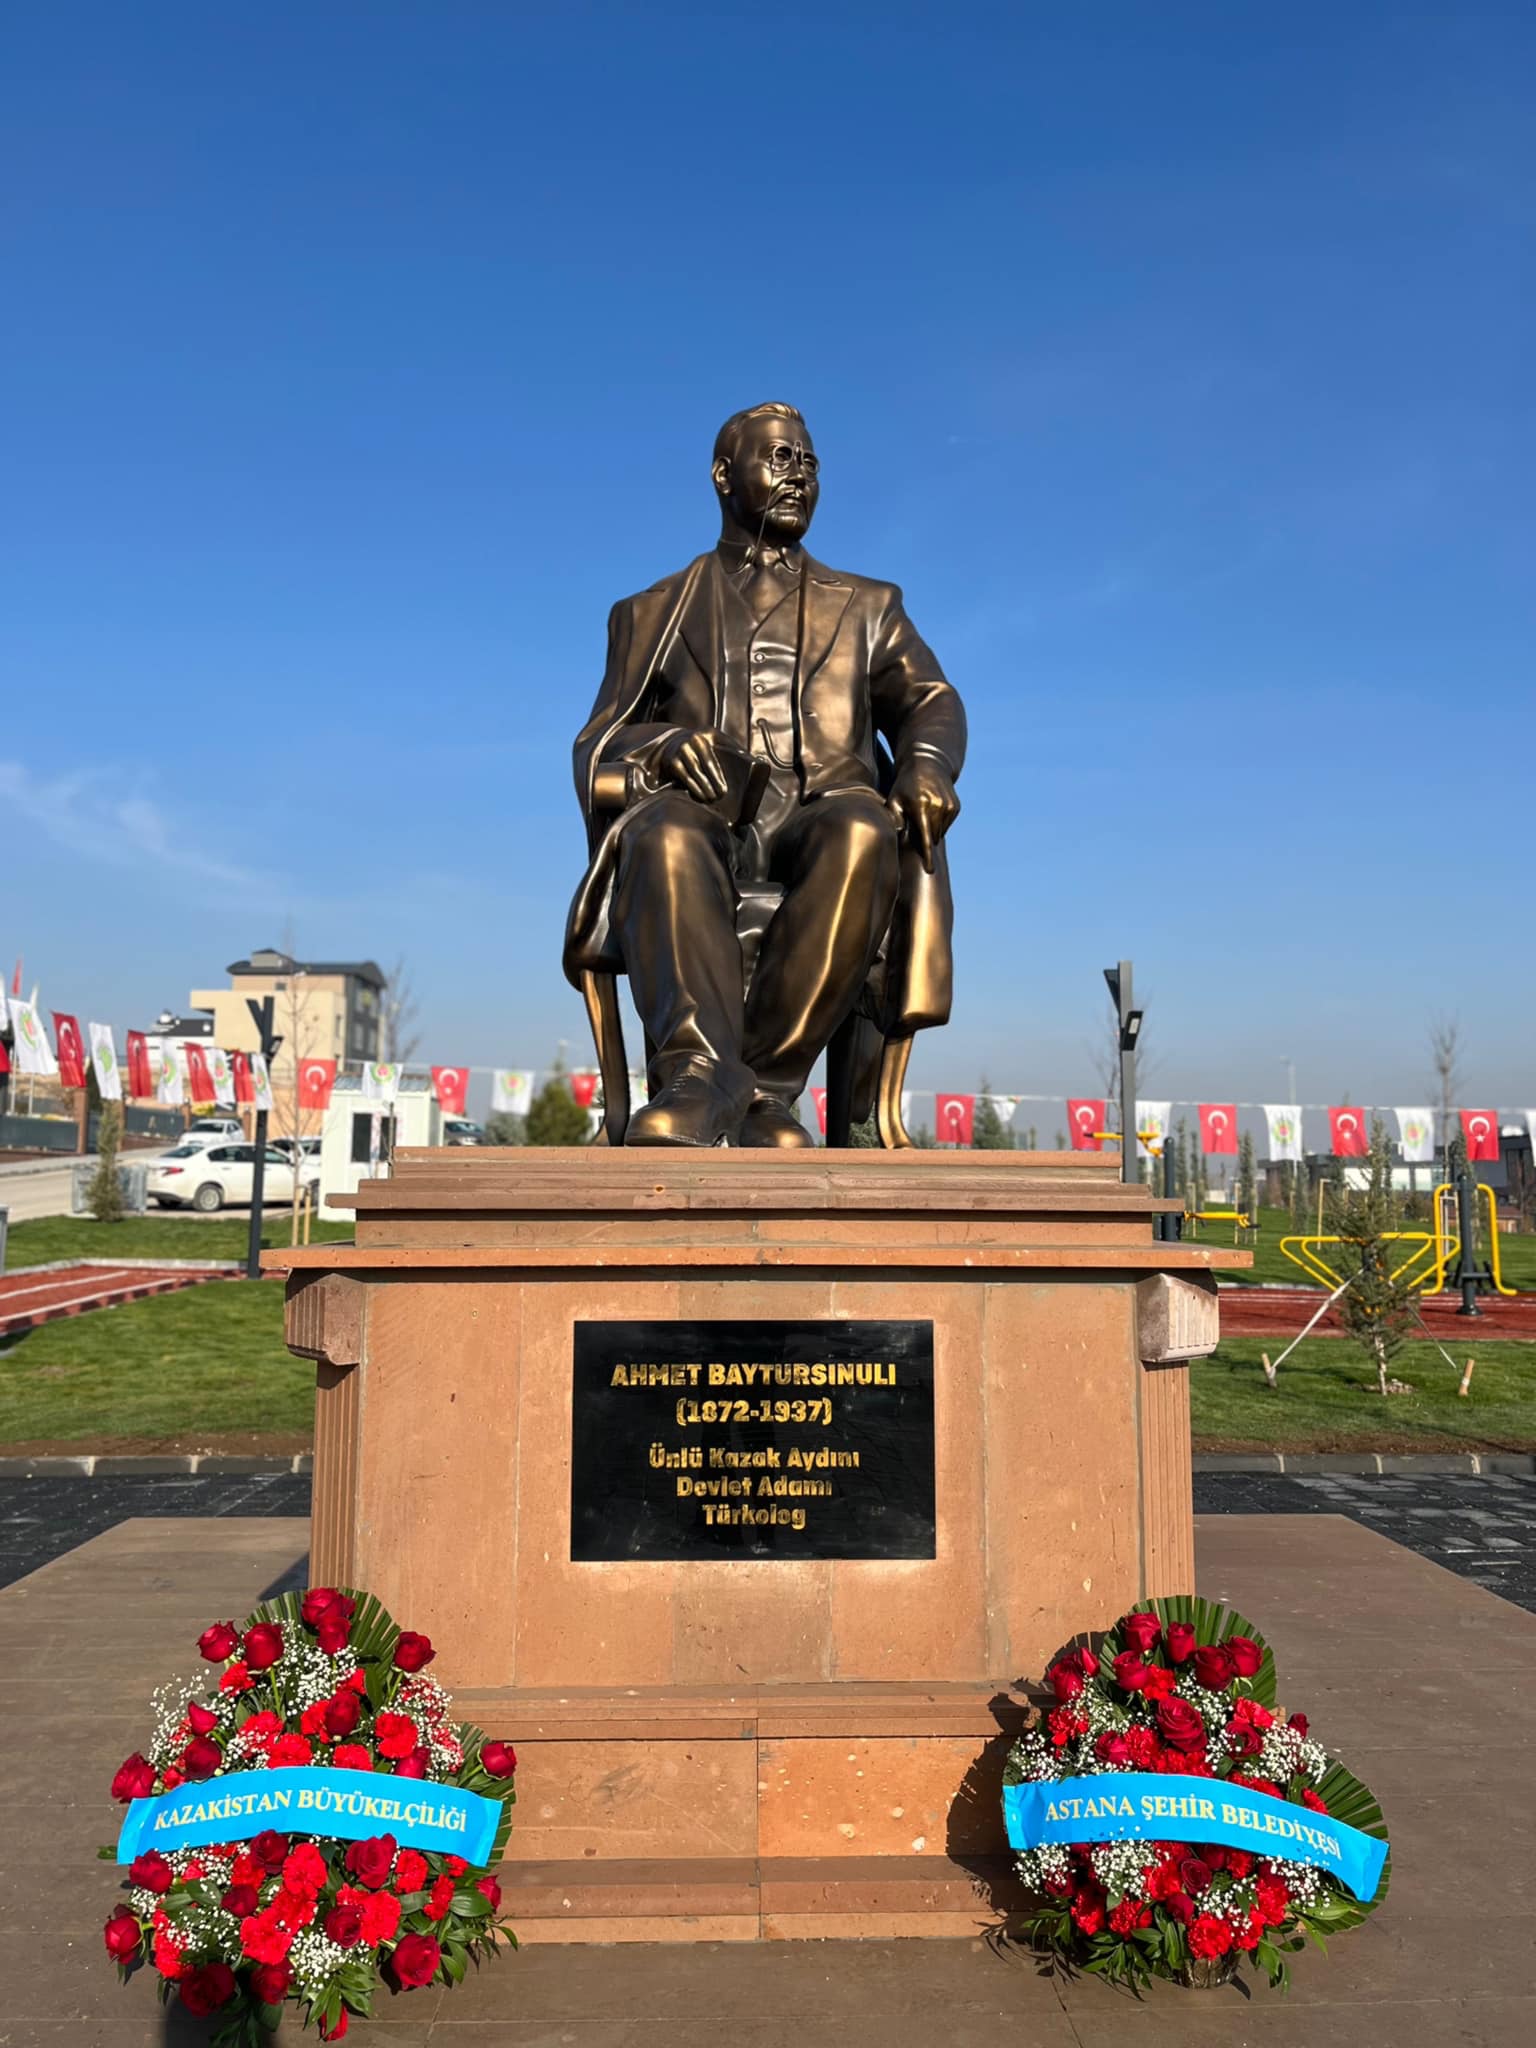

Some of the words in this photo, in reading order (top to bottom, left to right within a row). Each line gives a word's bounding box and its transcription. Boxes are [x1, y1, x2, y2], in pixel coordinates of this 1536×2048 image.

[610, 1363, 702, 1386] AHMET
[708, 1363, 896, 1386] BAYTURSINULI
[676, 1397, 832, 1426] (1872-1937)
[649, 1442, 703, 1468] Ünlü
[709, 1447, 781, 1468] Kazak
[787, 1447, 860, 1472] Aydını
[676, 1476, 752, 1497] Devlet
[757, 1475, 833, 1496] Adamı
[702, 1504, 806, 1530] Türkolog
[153, 1789, 293, 1831] KAZAKİSTAN
[297, 1786, 467, 1832] BÜYÜKELÇİLİĞİ
[1045, 1796, 1136, 1821] ASTANA
[1141, 1793, 1217, 1820] ŞEHİR
